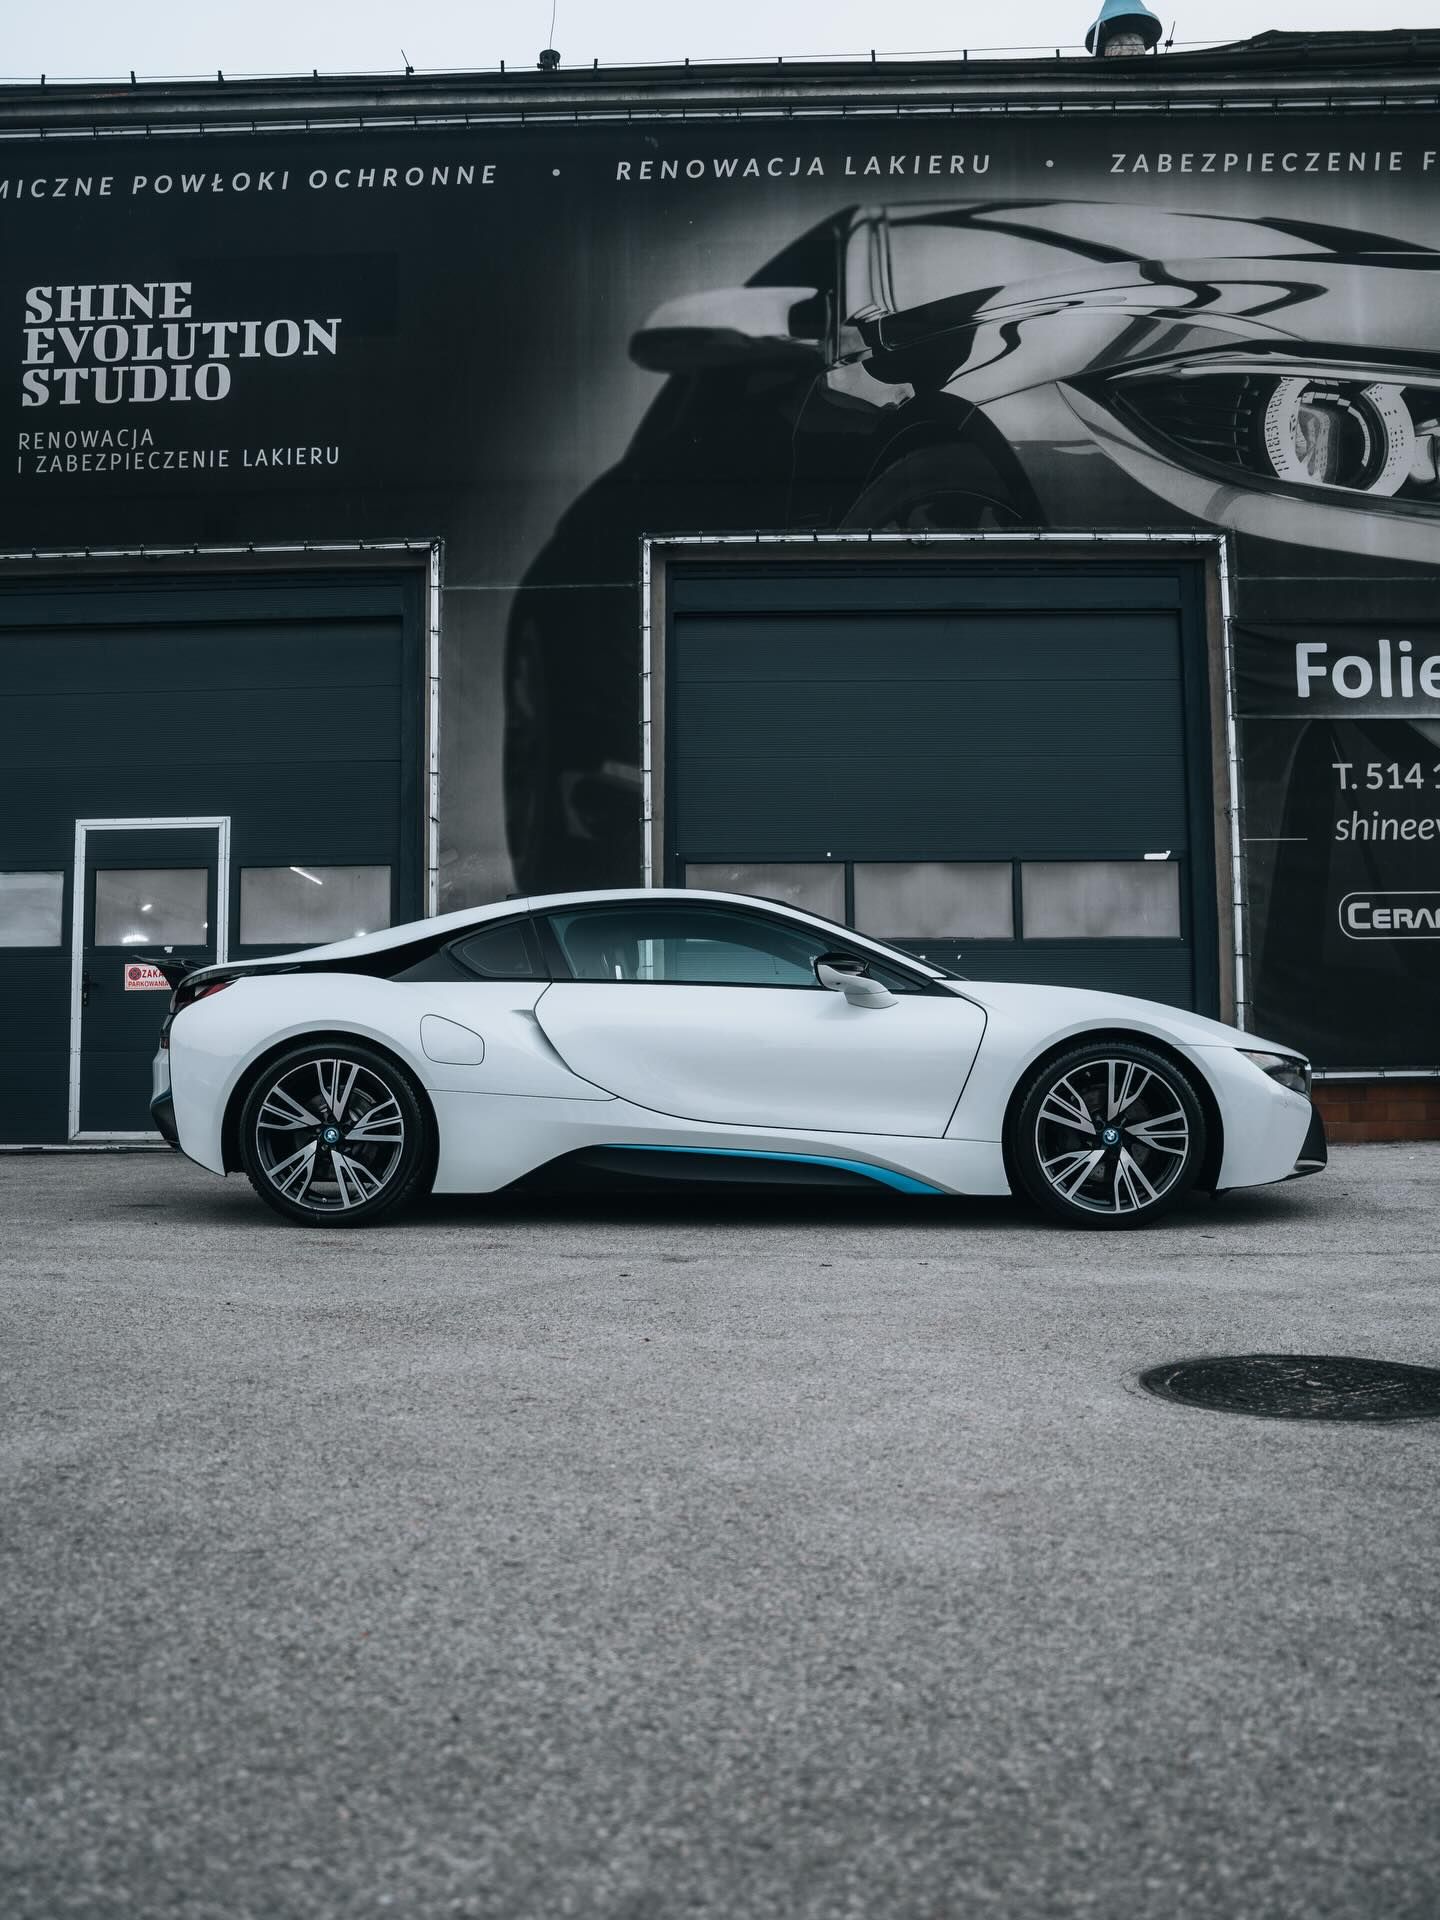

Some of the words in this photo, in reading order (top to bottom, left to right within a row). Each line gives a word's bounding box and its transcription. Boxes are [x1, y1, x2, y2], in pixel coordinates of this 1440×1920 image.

[616, 156, 825, 181] RENOWACJA
[845, 154, 990, 175] LAKIERU
[1110, 151, 1403, 173] ZABEZPIECZENIE
[1423, 151, 1437, 170] F
[132, 170, 289, 195] POWŁOKI
[309, 164, 497, 190] OCHRONNE
[25, 282, 192, 324] SHINE
[22, 318, 342, 364] EVOLUTION
[22, 363, 231, 407] STUDIO
[18, 428, 154, 450] RENOWACJA
[17, 456, 22, 474] I
[35, 450, 230, 473] ZABEZPIECZENIE
[243, 446, 339, 467] LAKIERU
[1296, 639, 1440, 699] Folie
[1331, 763, 1358, 790] T.
[1366, 762, 1425, 790] 514
